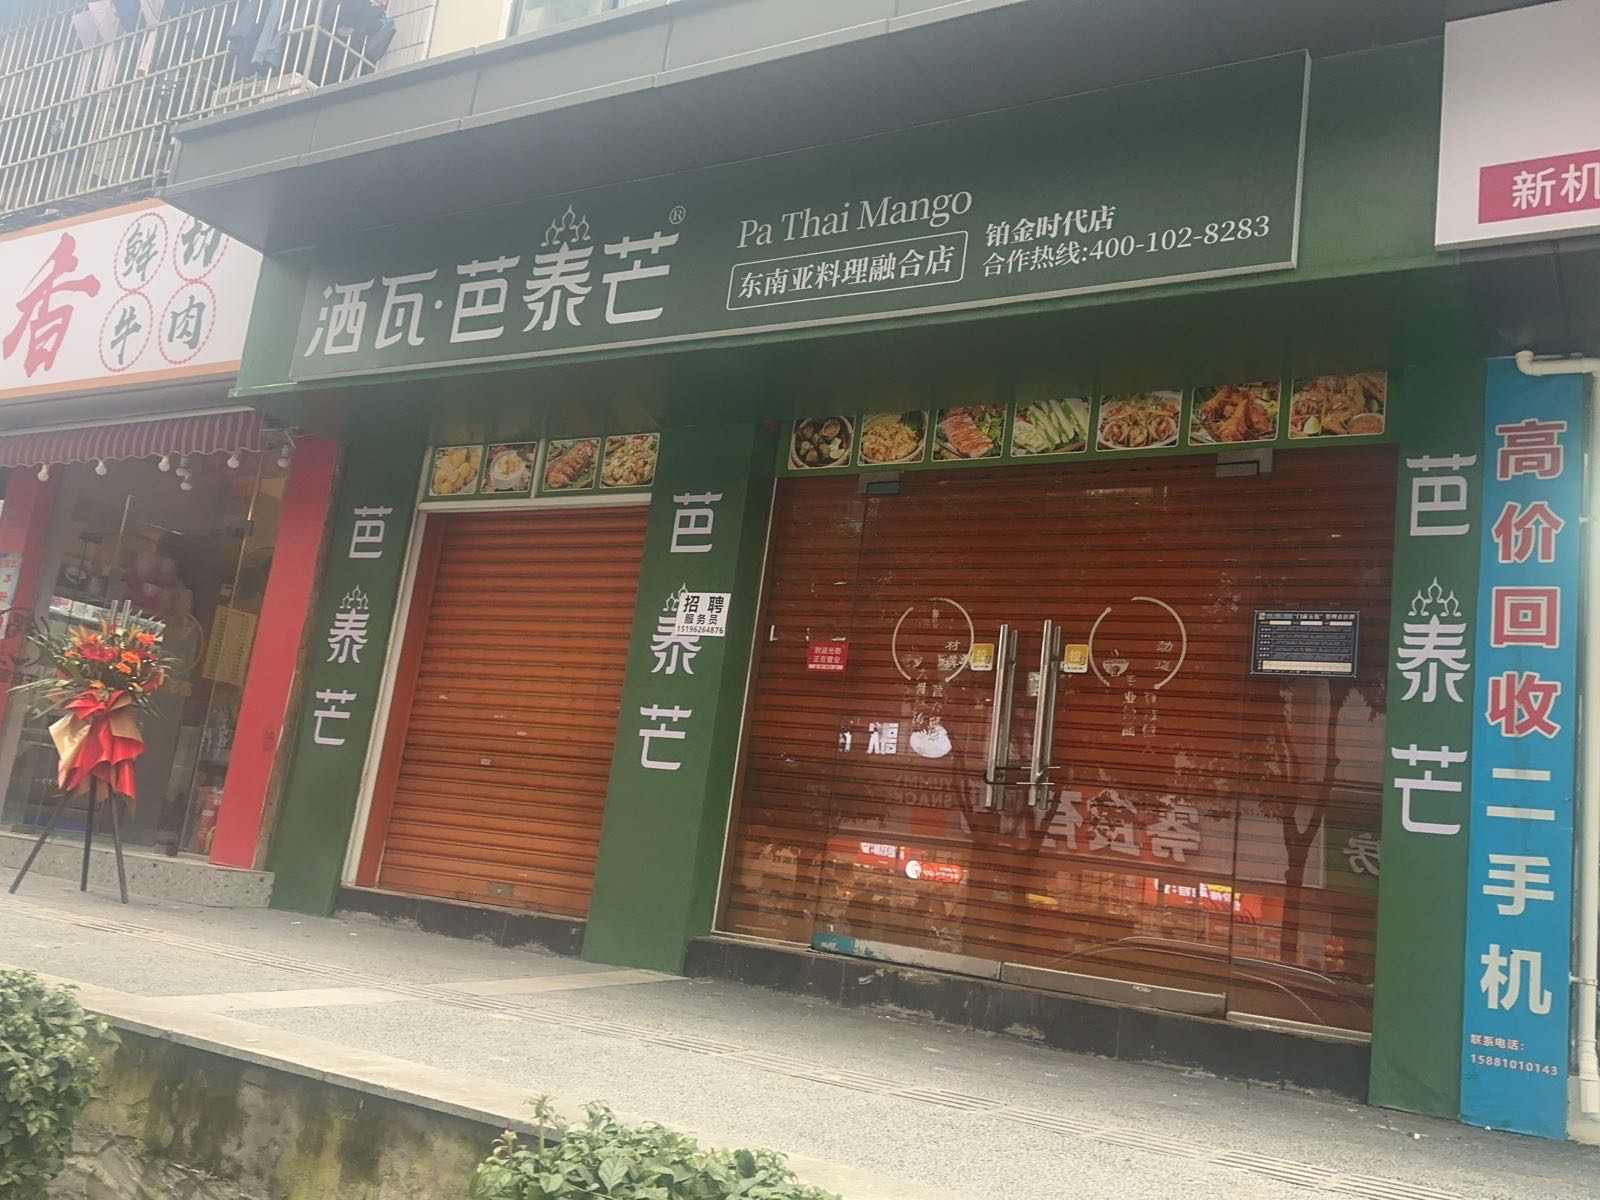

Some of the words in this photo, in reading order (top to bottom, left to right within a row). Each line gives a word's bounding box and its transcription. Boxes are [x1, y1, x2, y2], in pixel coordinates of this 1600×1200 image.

[1511, 163, 1600, 210] 新机
[736, 219, 773, 249] Pa
[781, 202, 850, 242] Thai
[856, 191, 972, 228] Mango
[985, 205, 1117, 248] 铂金时代店
[738, 244, 955, 299] 东南亚料理融合店
[982, 215, 1270, 278] 合作热线:400-102-8283
[2, 232, 101, 378] 香
[313, 506, 393, 745] 芭泰芒
[683, 595, 724, 613] 招聘
[684, 614, 718, 625] 服务员
[677, 626, 724, 634] 15196264876
[1391, 454, 1477, 835] 芭泰芒
[1470, 1053, 1559, 1076] 15881010143
